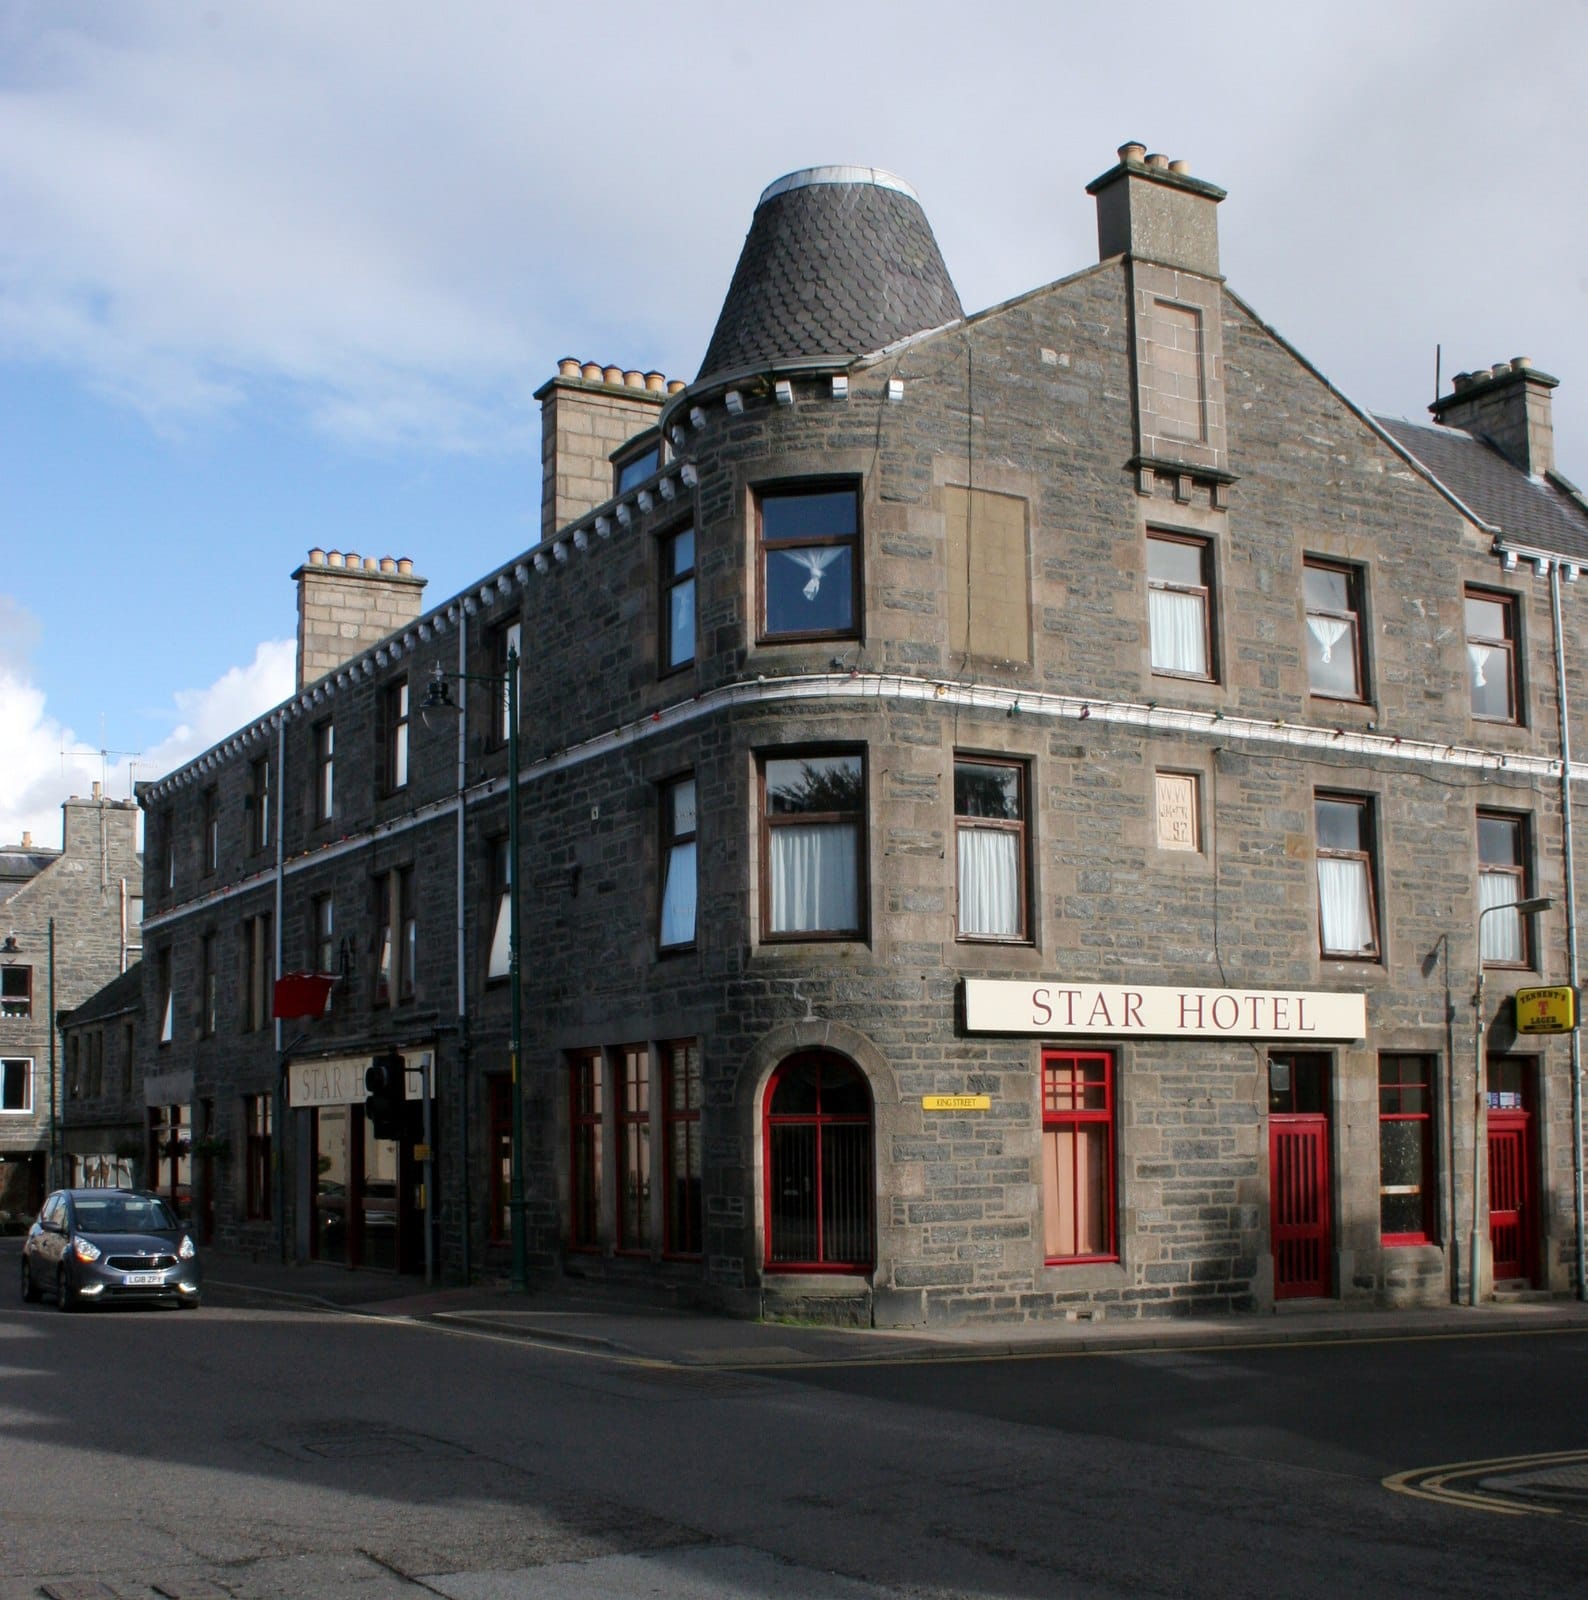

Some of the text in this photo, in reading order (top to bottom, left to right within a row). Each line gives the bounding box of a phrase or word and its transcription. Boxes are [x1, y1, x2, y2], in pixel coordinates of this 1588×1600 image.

[1520, 991, 1566, 1004] TENNENT'S
[1032, 988, 1316, 1031] STAR HOTEL
[1530, 1016, 1557, 1024] LAGER
[303, 1067, 343, 1101] STAR
